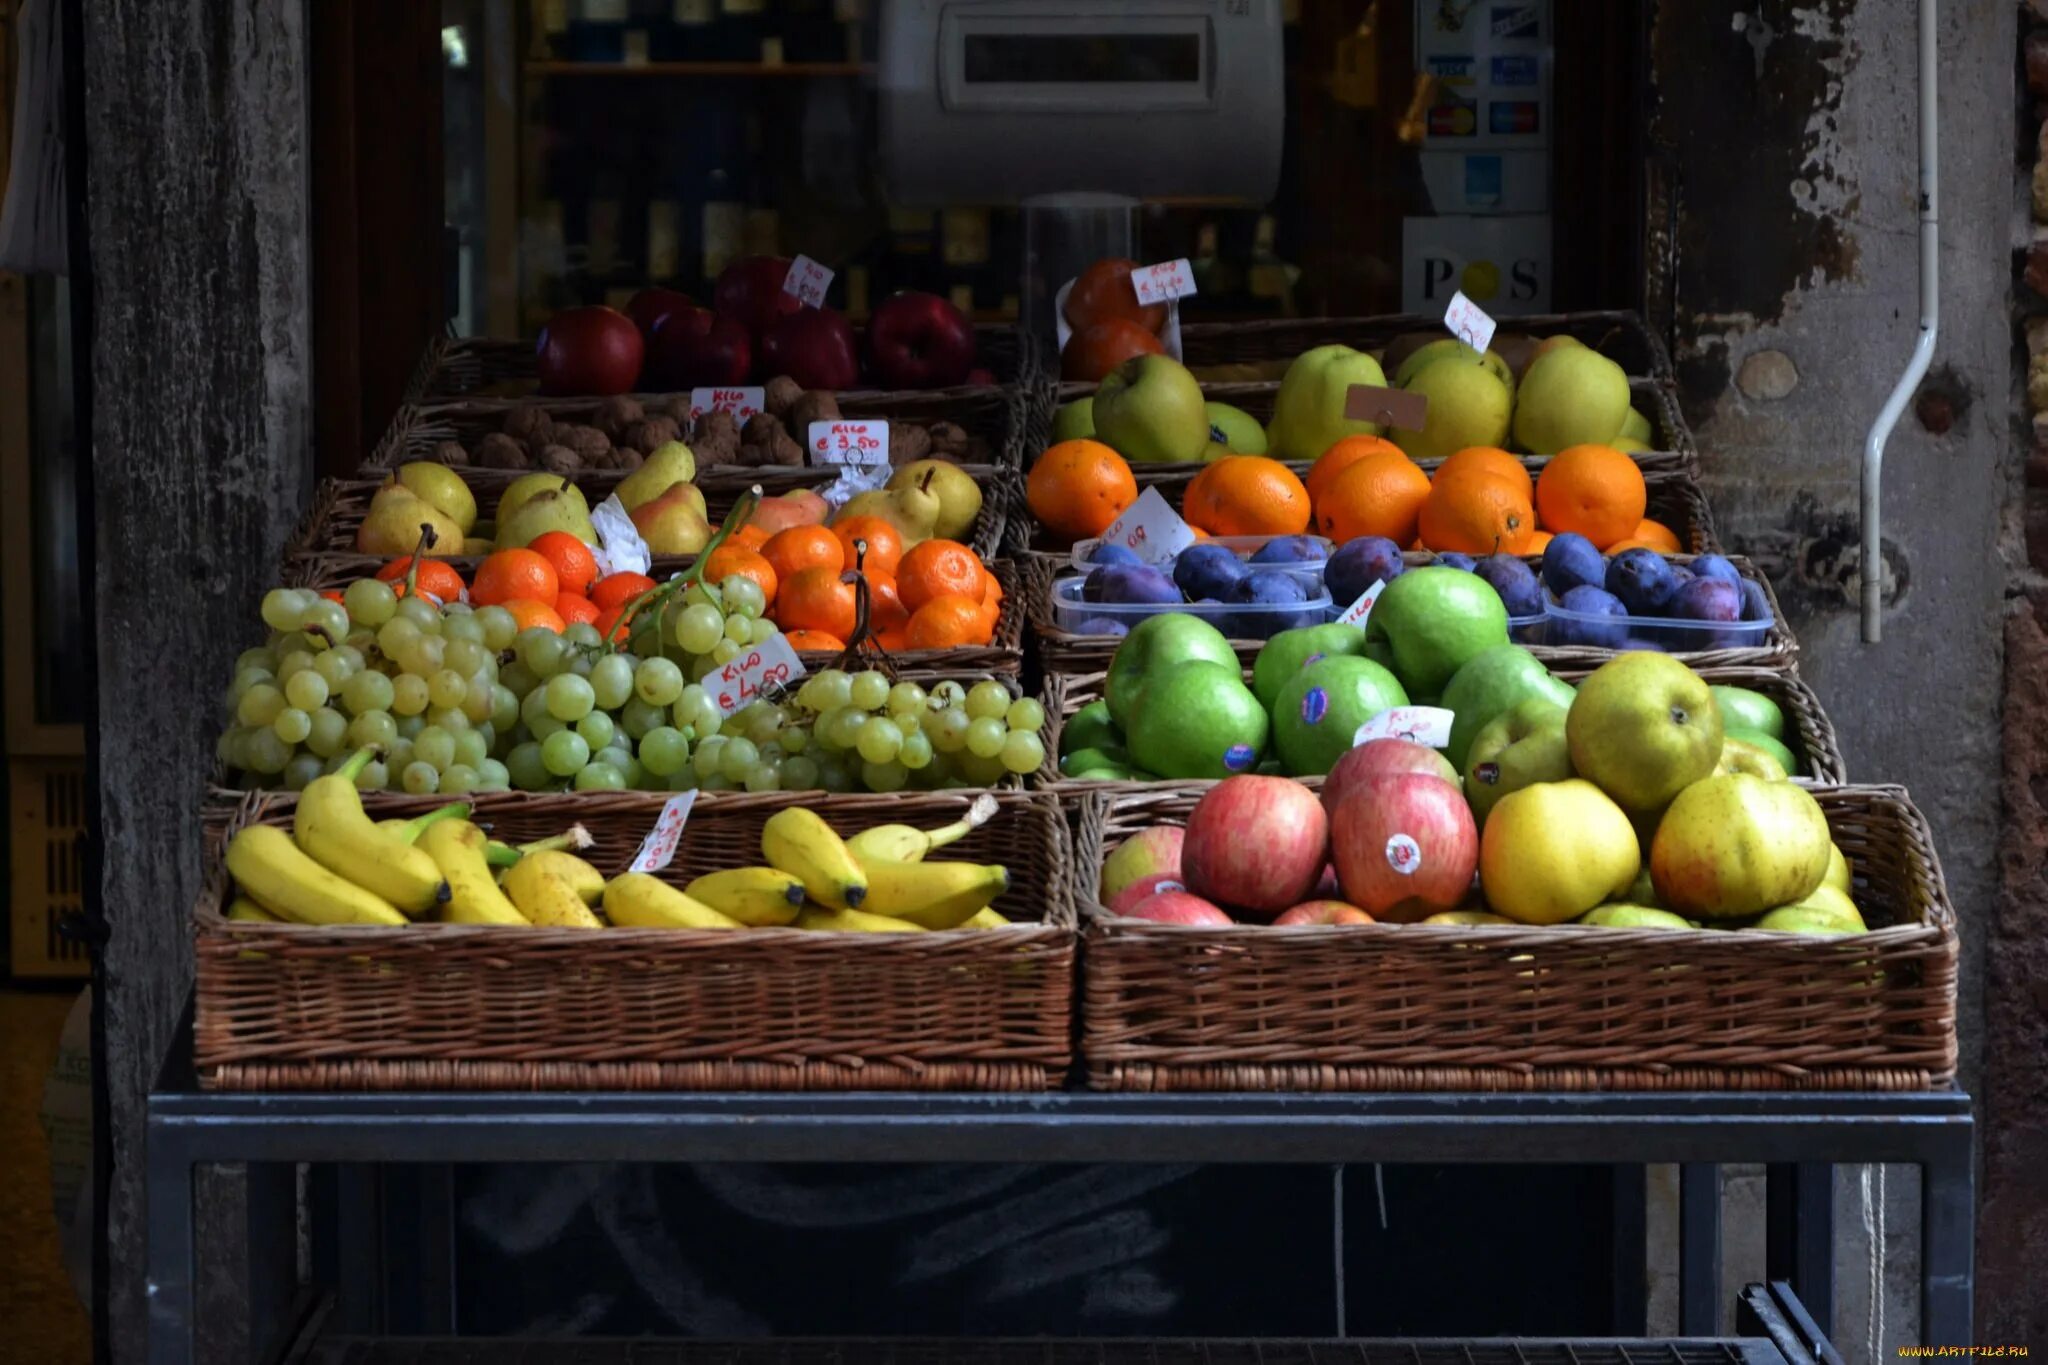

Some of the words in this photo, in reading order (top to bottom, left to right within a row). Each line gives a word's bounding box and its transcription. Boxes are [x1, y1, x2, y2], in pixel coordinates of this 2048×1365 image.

[713, 389, 744, 403] KILO
[831, 424, 868, 434] KILO
[721, 652, 761, 682] KILO
